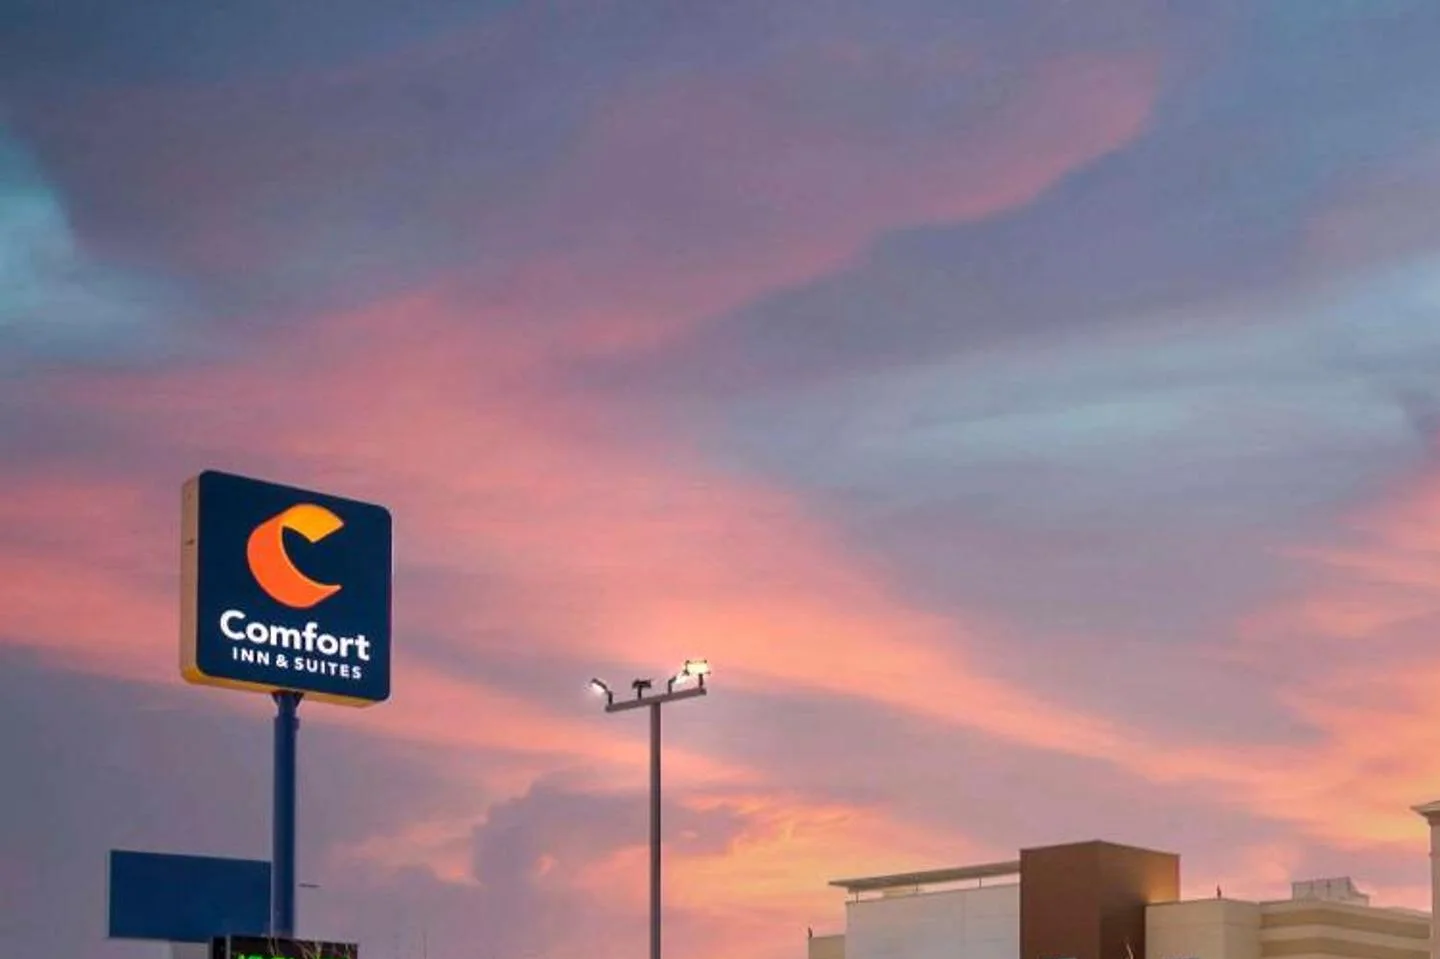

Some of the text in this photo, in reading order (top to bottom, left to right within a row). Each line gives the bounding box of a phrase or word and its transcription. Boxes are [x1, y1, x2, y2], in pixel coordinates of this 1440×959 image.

[220, 609, 371, 661] Comfort
[232, 646, 362, 679] INN & SUITES
